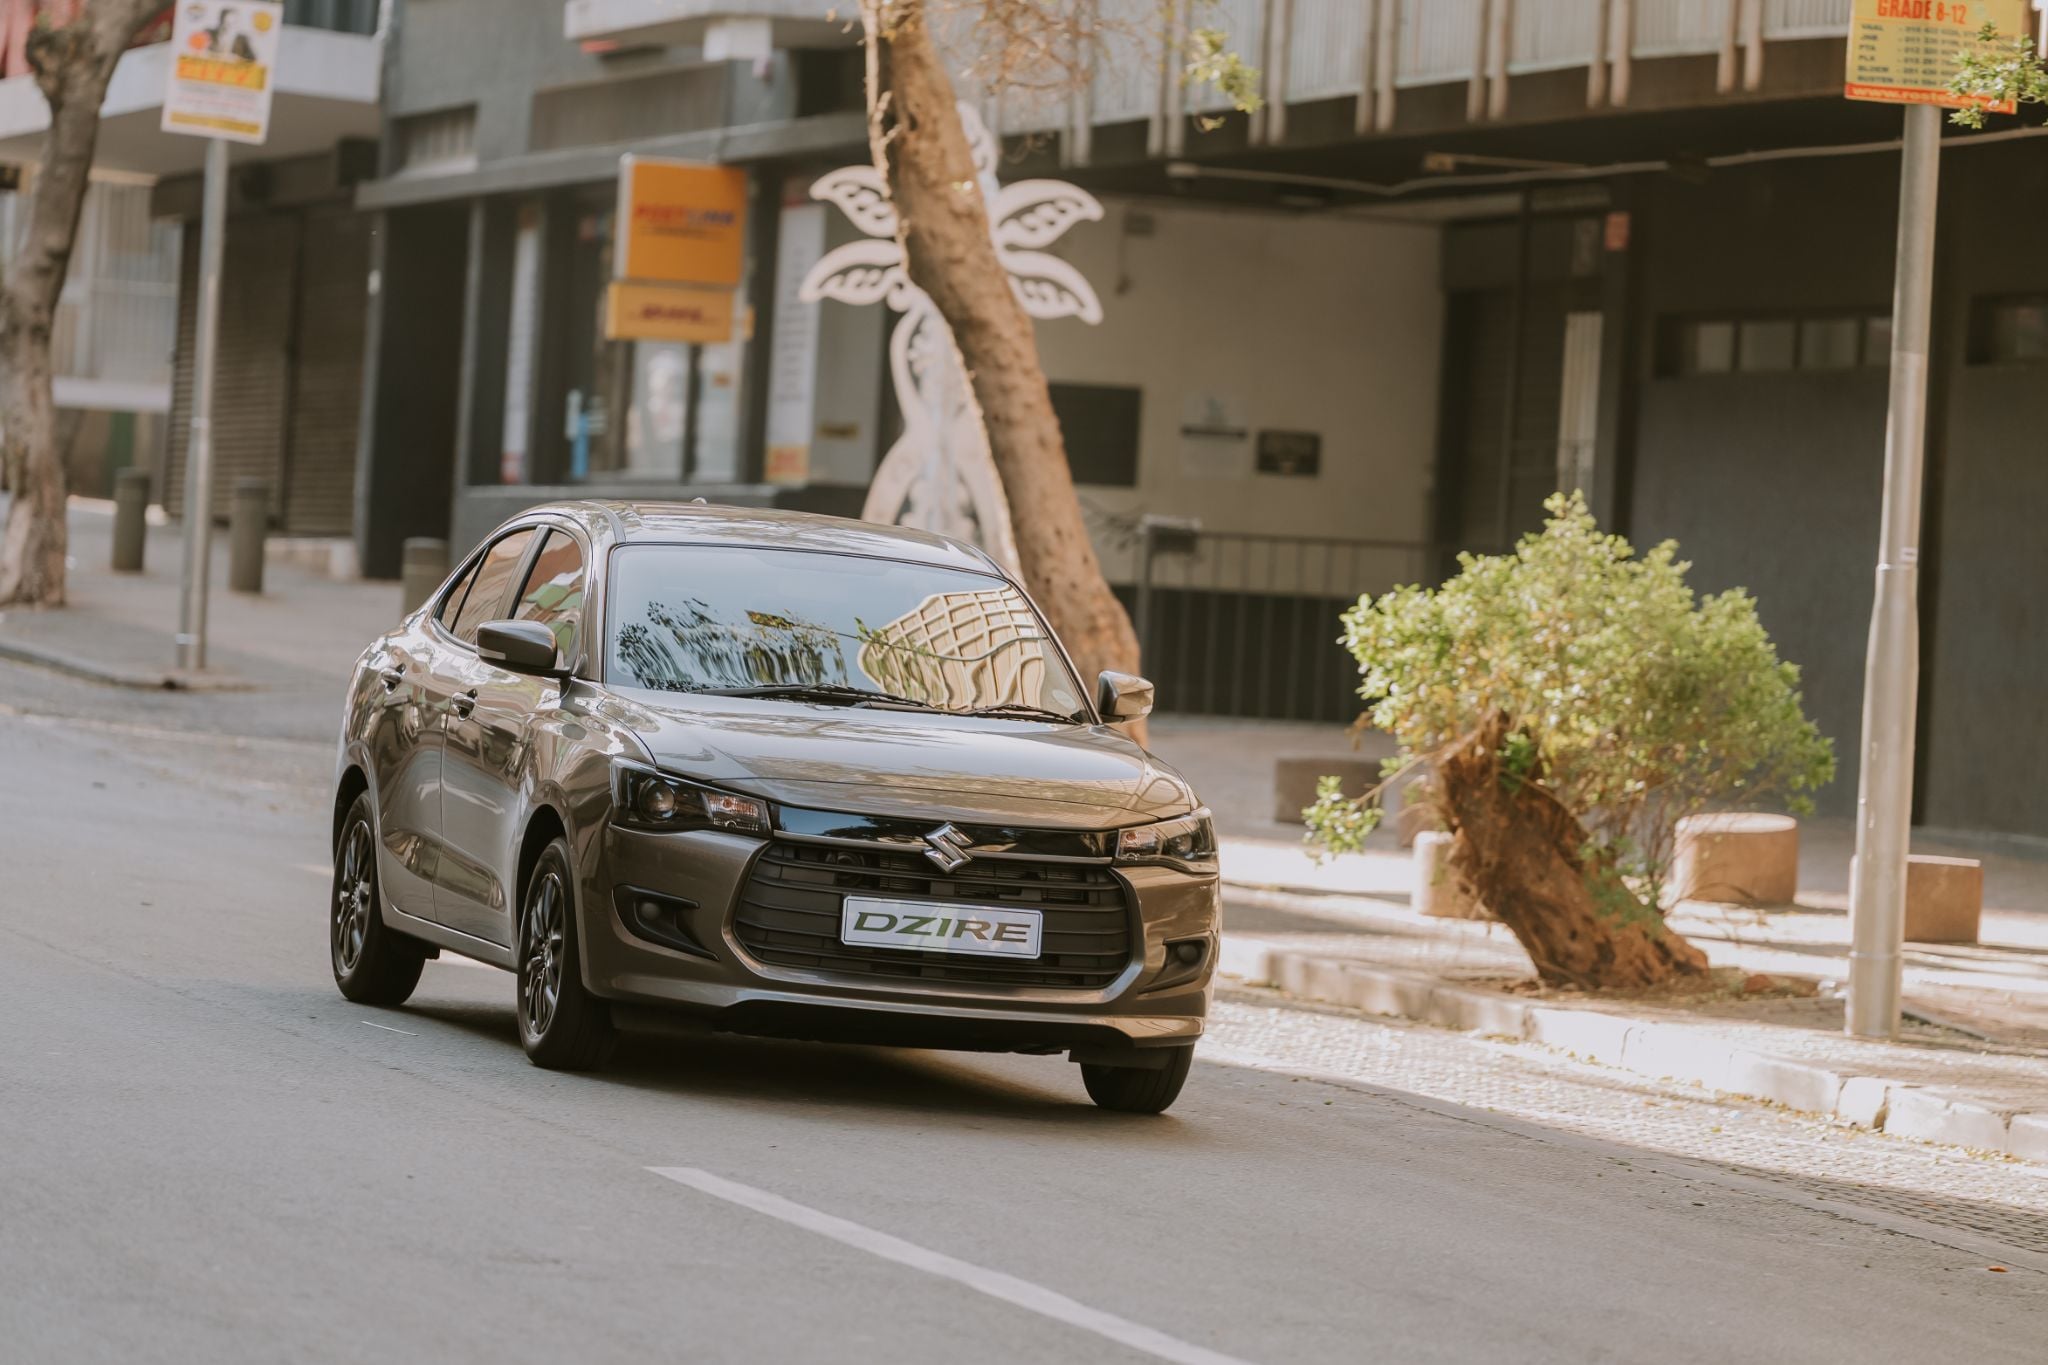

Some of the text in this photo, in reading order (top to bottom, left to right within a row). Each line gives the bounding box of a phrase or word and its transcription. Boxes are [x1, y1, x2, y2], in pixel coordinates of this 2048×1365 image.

[1876, 0, 1967, 25] GRADE 8-12
[853, 911, 1031, 943] DZIRE
